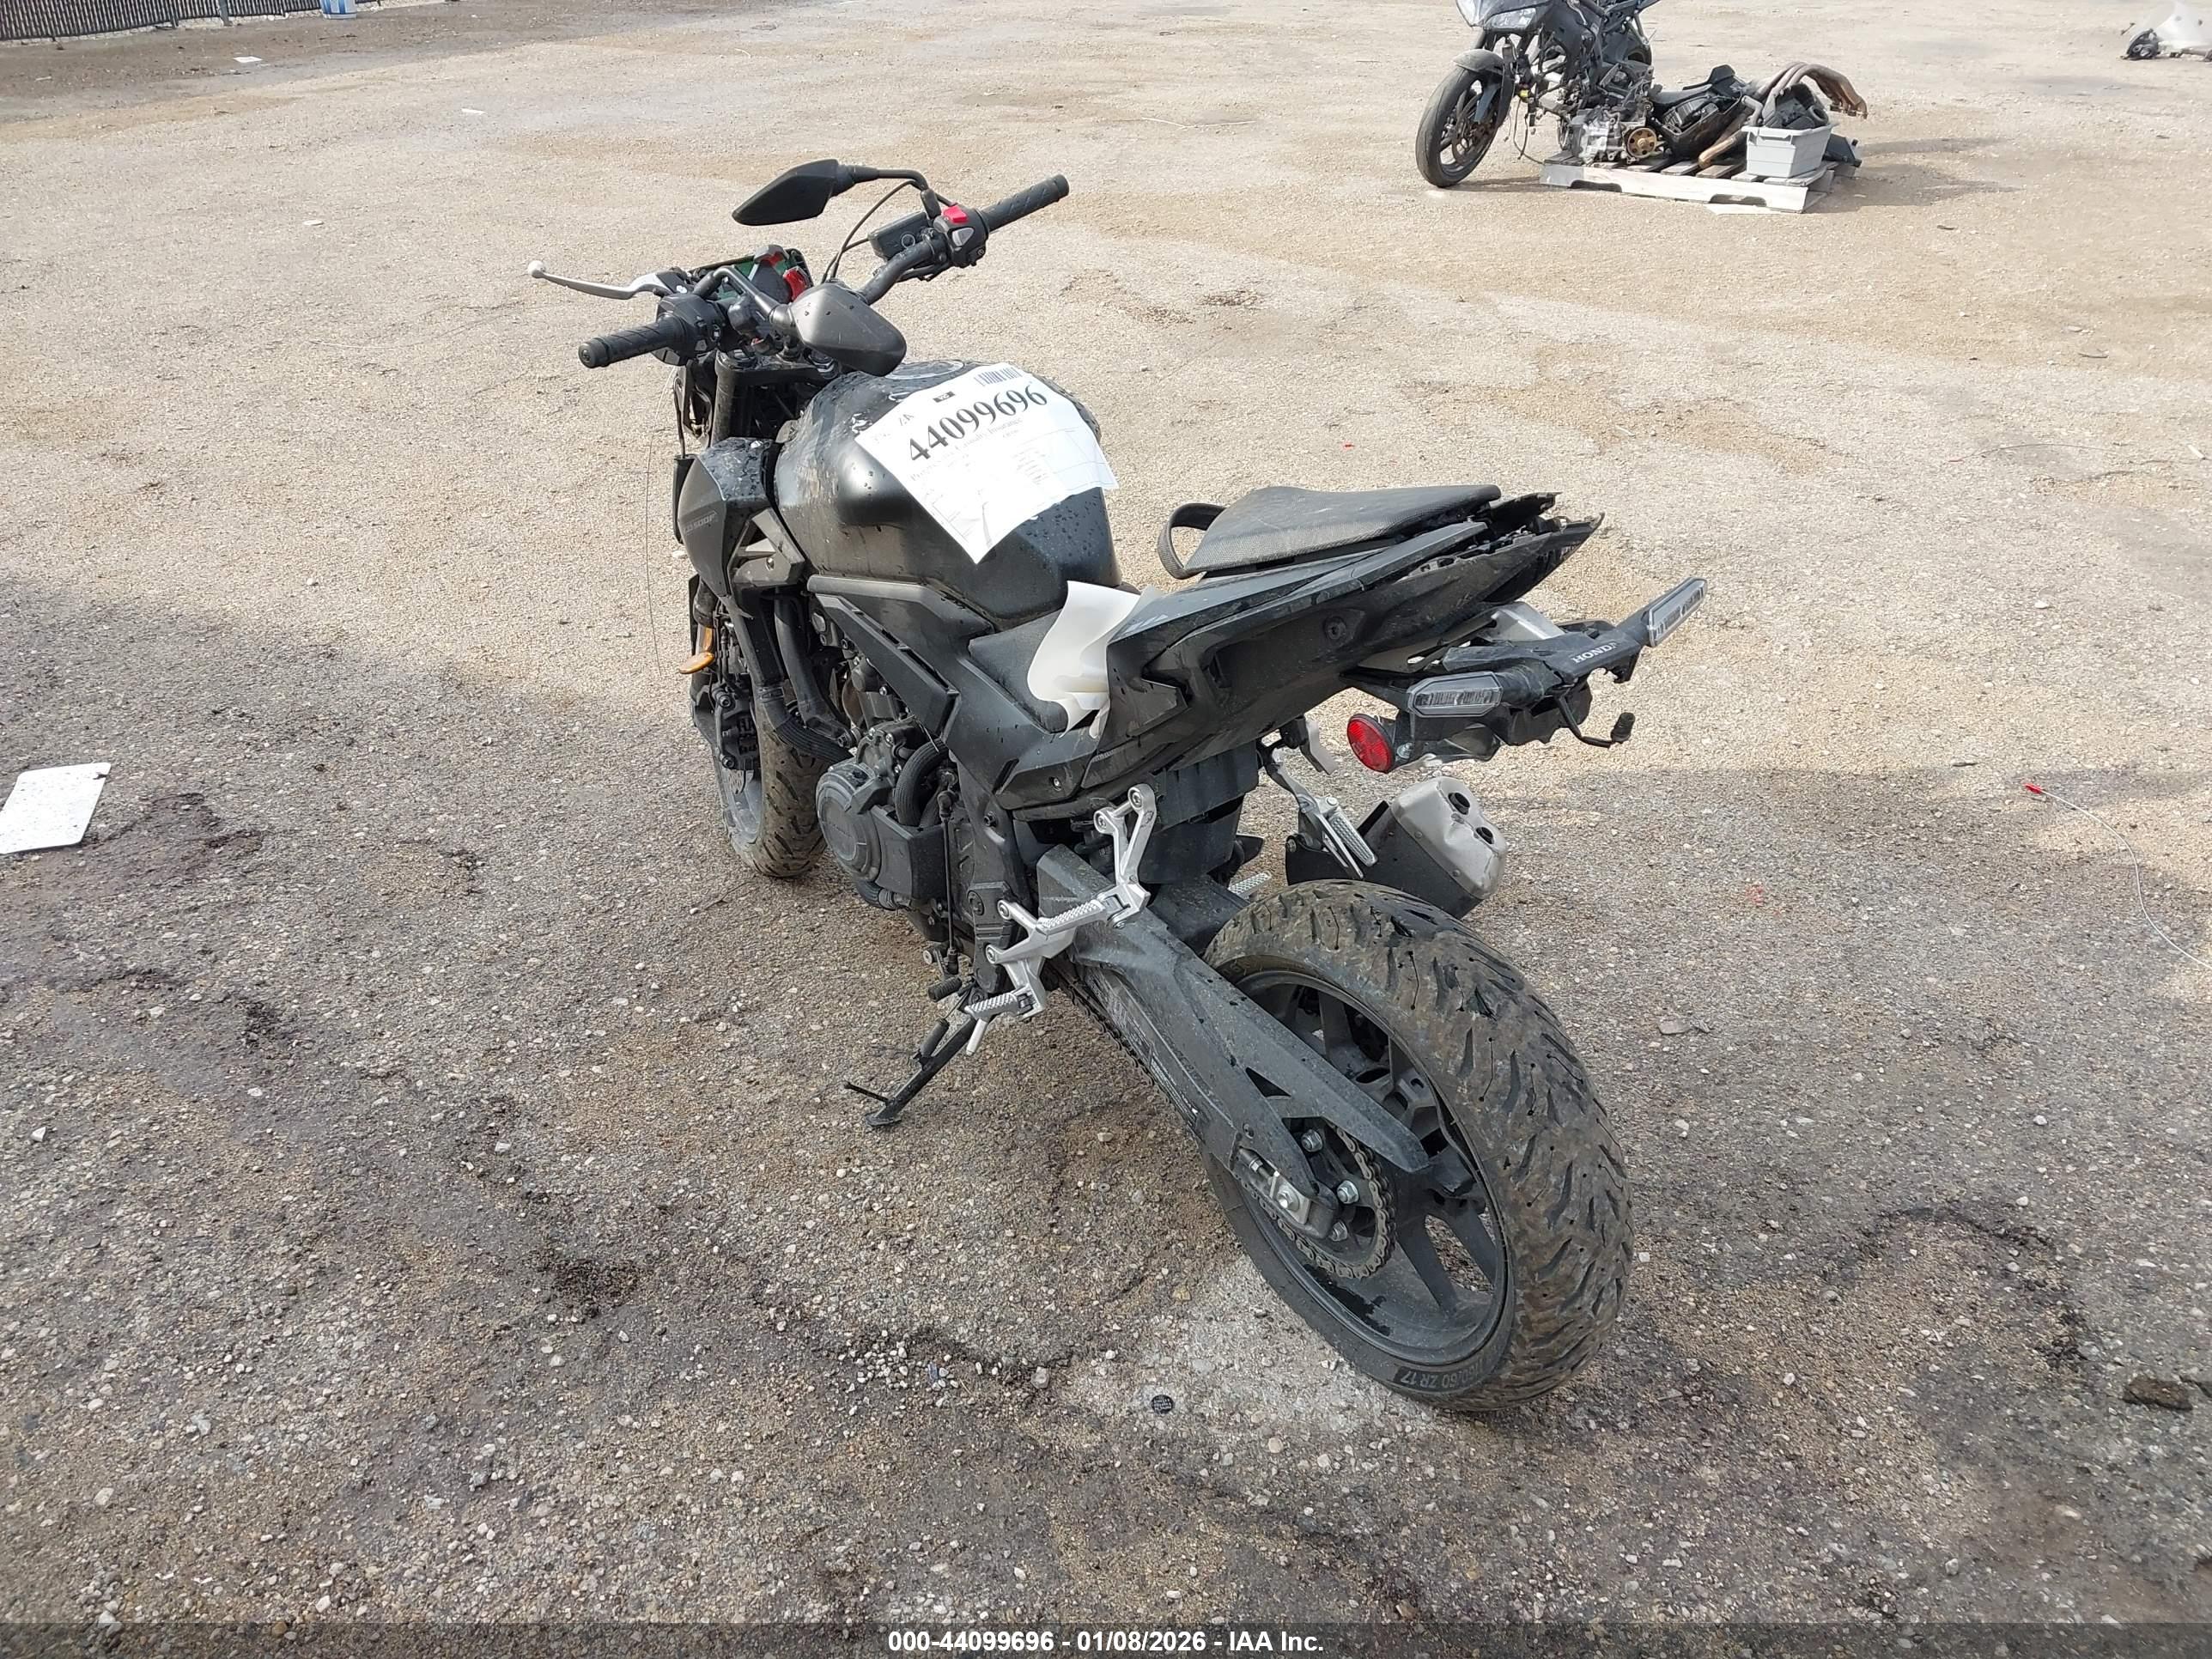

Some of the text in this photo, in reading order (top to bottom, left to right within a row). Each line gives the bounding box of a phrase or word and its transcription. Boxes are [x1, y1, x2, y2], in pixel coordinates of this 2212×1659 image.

[908, 384, 1048, 461] 44099696
[1571, 641, 1620, 663] HONDA
[1401, 1370, 1417, 1385] 17
[1419, 1373, 1439, 1389] ZR
